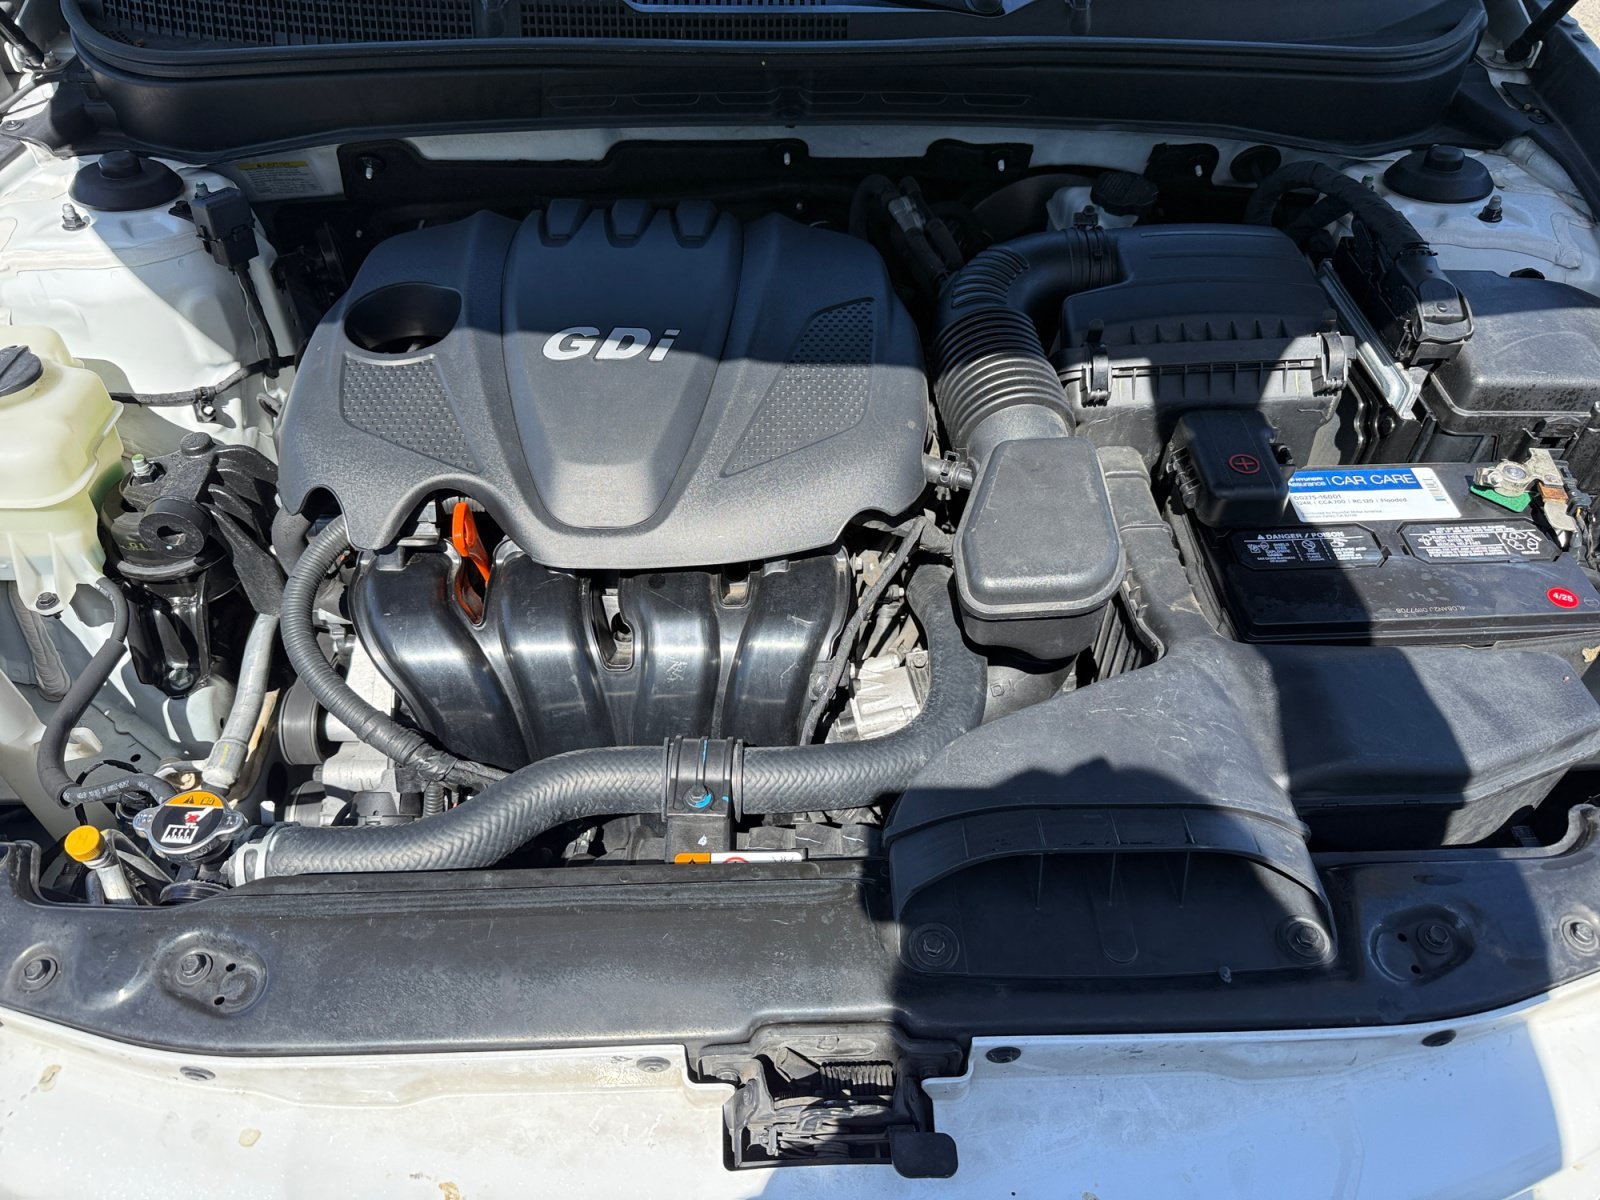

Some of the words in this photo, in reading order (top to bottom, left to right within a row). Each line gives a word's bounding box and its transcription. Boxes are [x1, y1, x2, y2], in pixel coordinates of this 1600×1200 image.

[542, 326, 681, 362] GDi
[1331, 475, 1368, 486] CAR
[1370, 474, 1417, 485] CARE
[1552, 592, 1574, 602] 4/25
